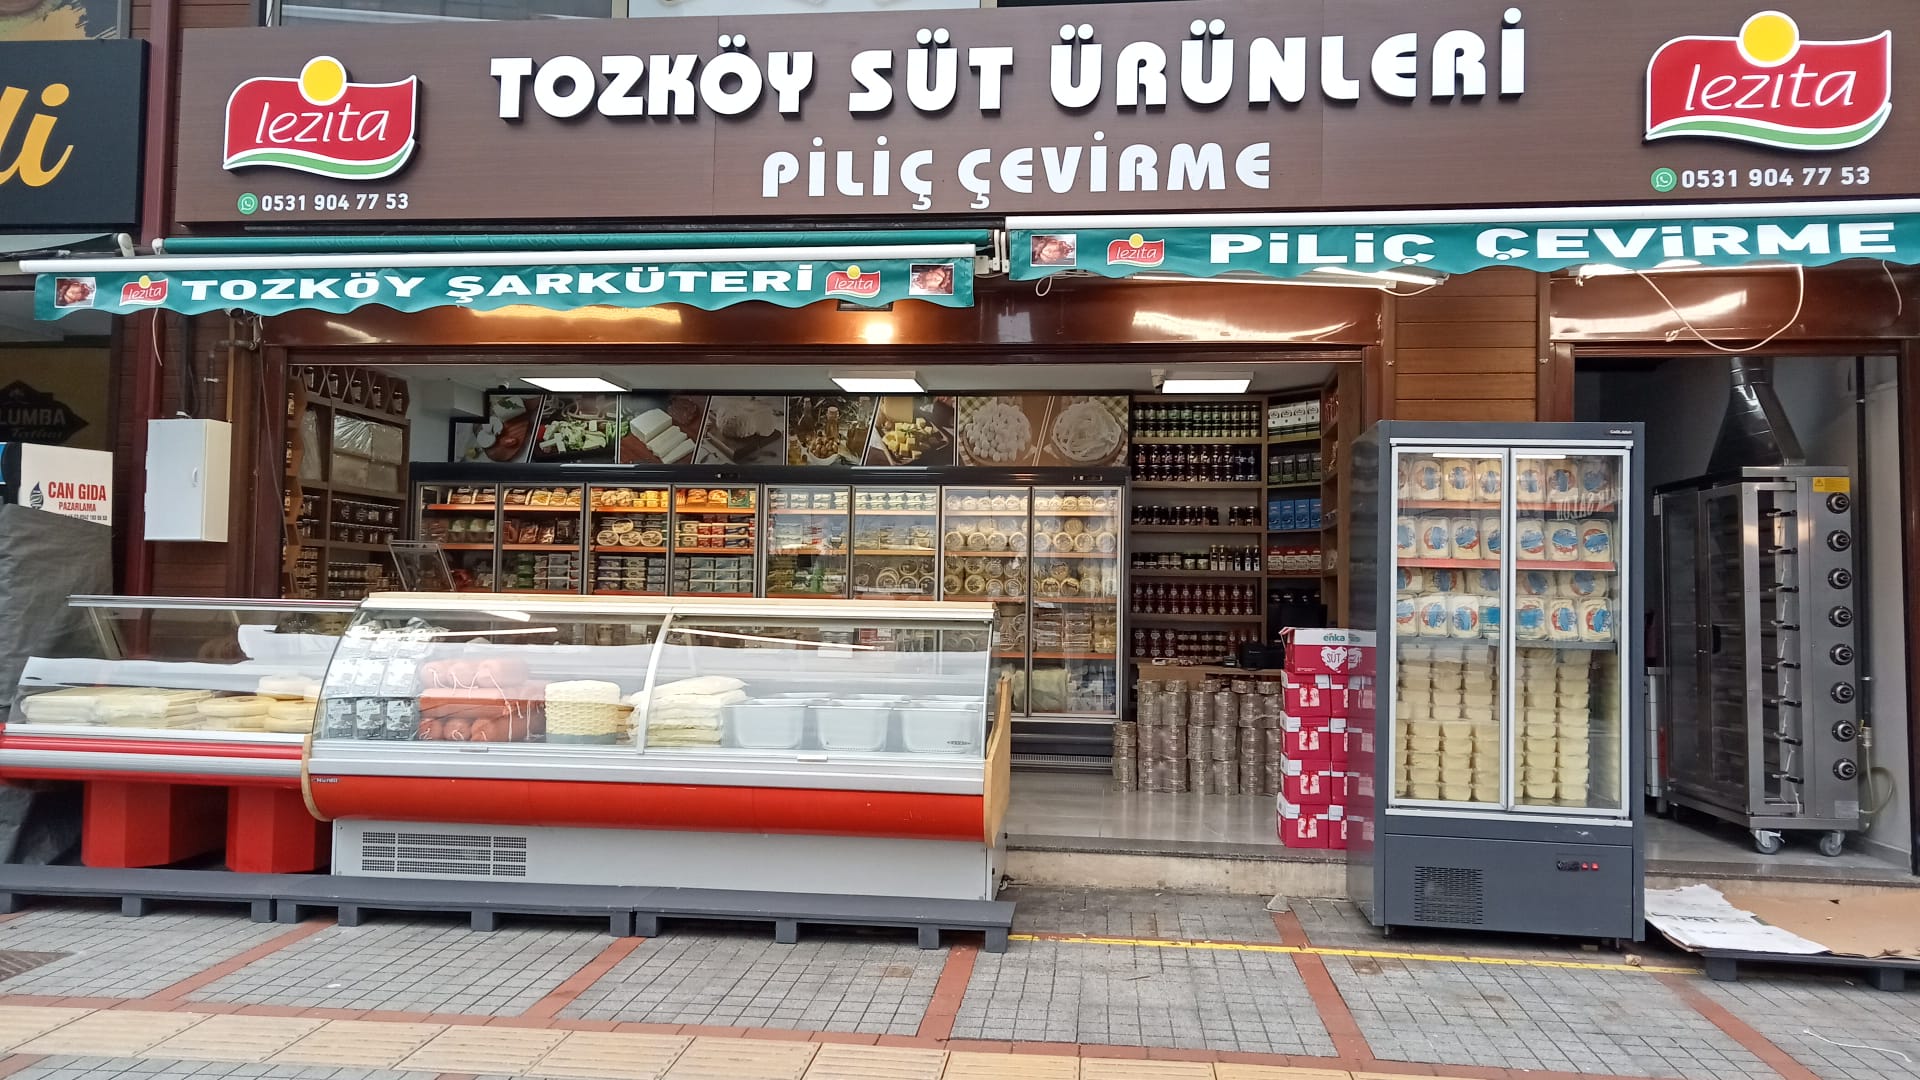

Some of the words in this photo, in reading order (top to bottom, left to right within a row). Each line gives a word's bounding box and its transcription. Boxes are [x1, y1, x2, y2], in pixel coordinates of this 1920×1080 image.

[491, 33, 814, 118] TOZKÖY
[849, 27, 1014, 112] SÜT
[1050, 7, 1525, 108] ÜRÜNLERİ
[762, 136, 933, 210] PİLİÇ
[957, 130, 1270, 210] ÇEVİRME
[1681, 169, 1737, 189] 0531
[1748, 168, 1794, 187] 904
[1802, 167, 1832, 186] 77
[1840, 166, 1871, 185] 53
[261, 194, 306, 212] 0531
[314, 194, 350, 211] 904
[356, 193, 380, 210] 77
[385, 193, 409, 210] 53
[182, 271, 425, 302] TOZKÖY
[447, 263, 814, 304] ŞARKÜTERİ
[48, 481, 74, 499] CAN
[78, 483, 107, 501] GIDA
[58, 501, 97, 512] PAZARLAMA
